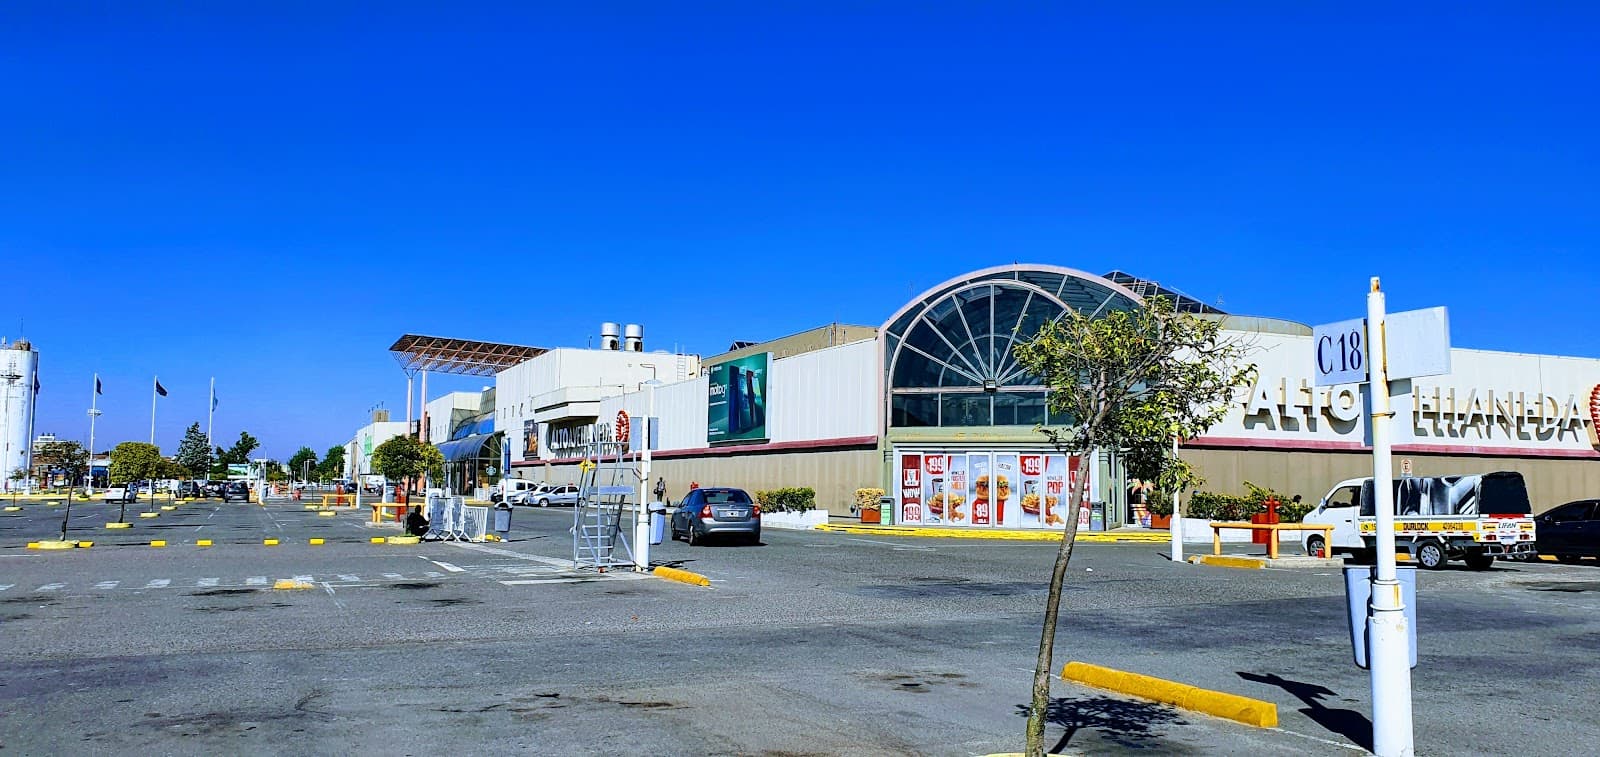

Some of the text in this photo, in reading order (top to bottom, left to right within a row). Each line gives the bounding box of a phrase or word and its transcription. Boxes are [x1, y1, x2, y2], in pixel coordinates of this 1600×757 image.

[1318, 331, 1362, 375] C 18
[1247, 376, 1586, 429] ALTO ELLANEDA
[902, 488, 920, 499] WOW
[1047, 481, 1063, 494] POP
[905, 506, 920, 521] 199
